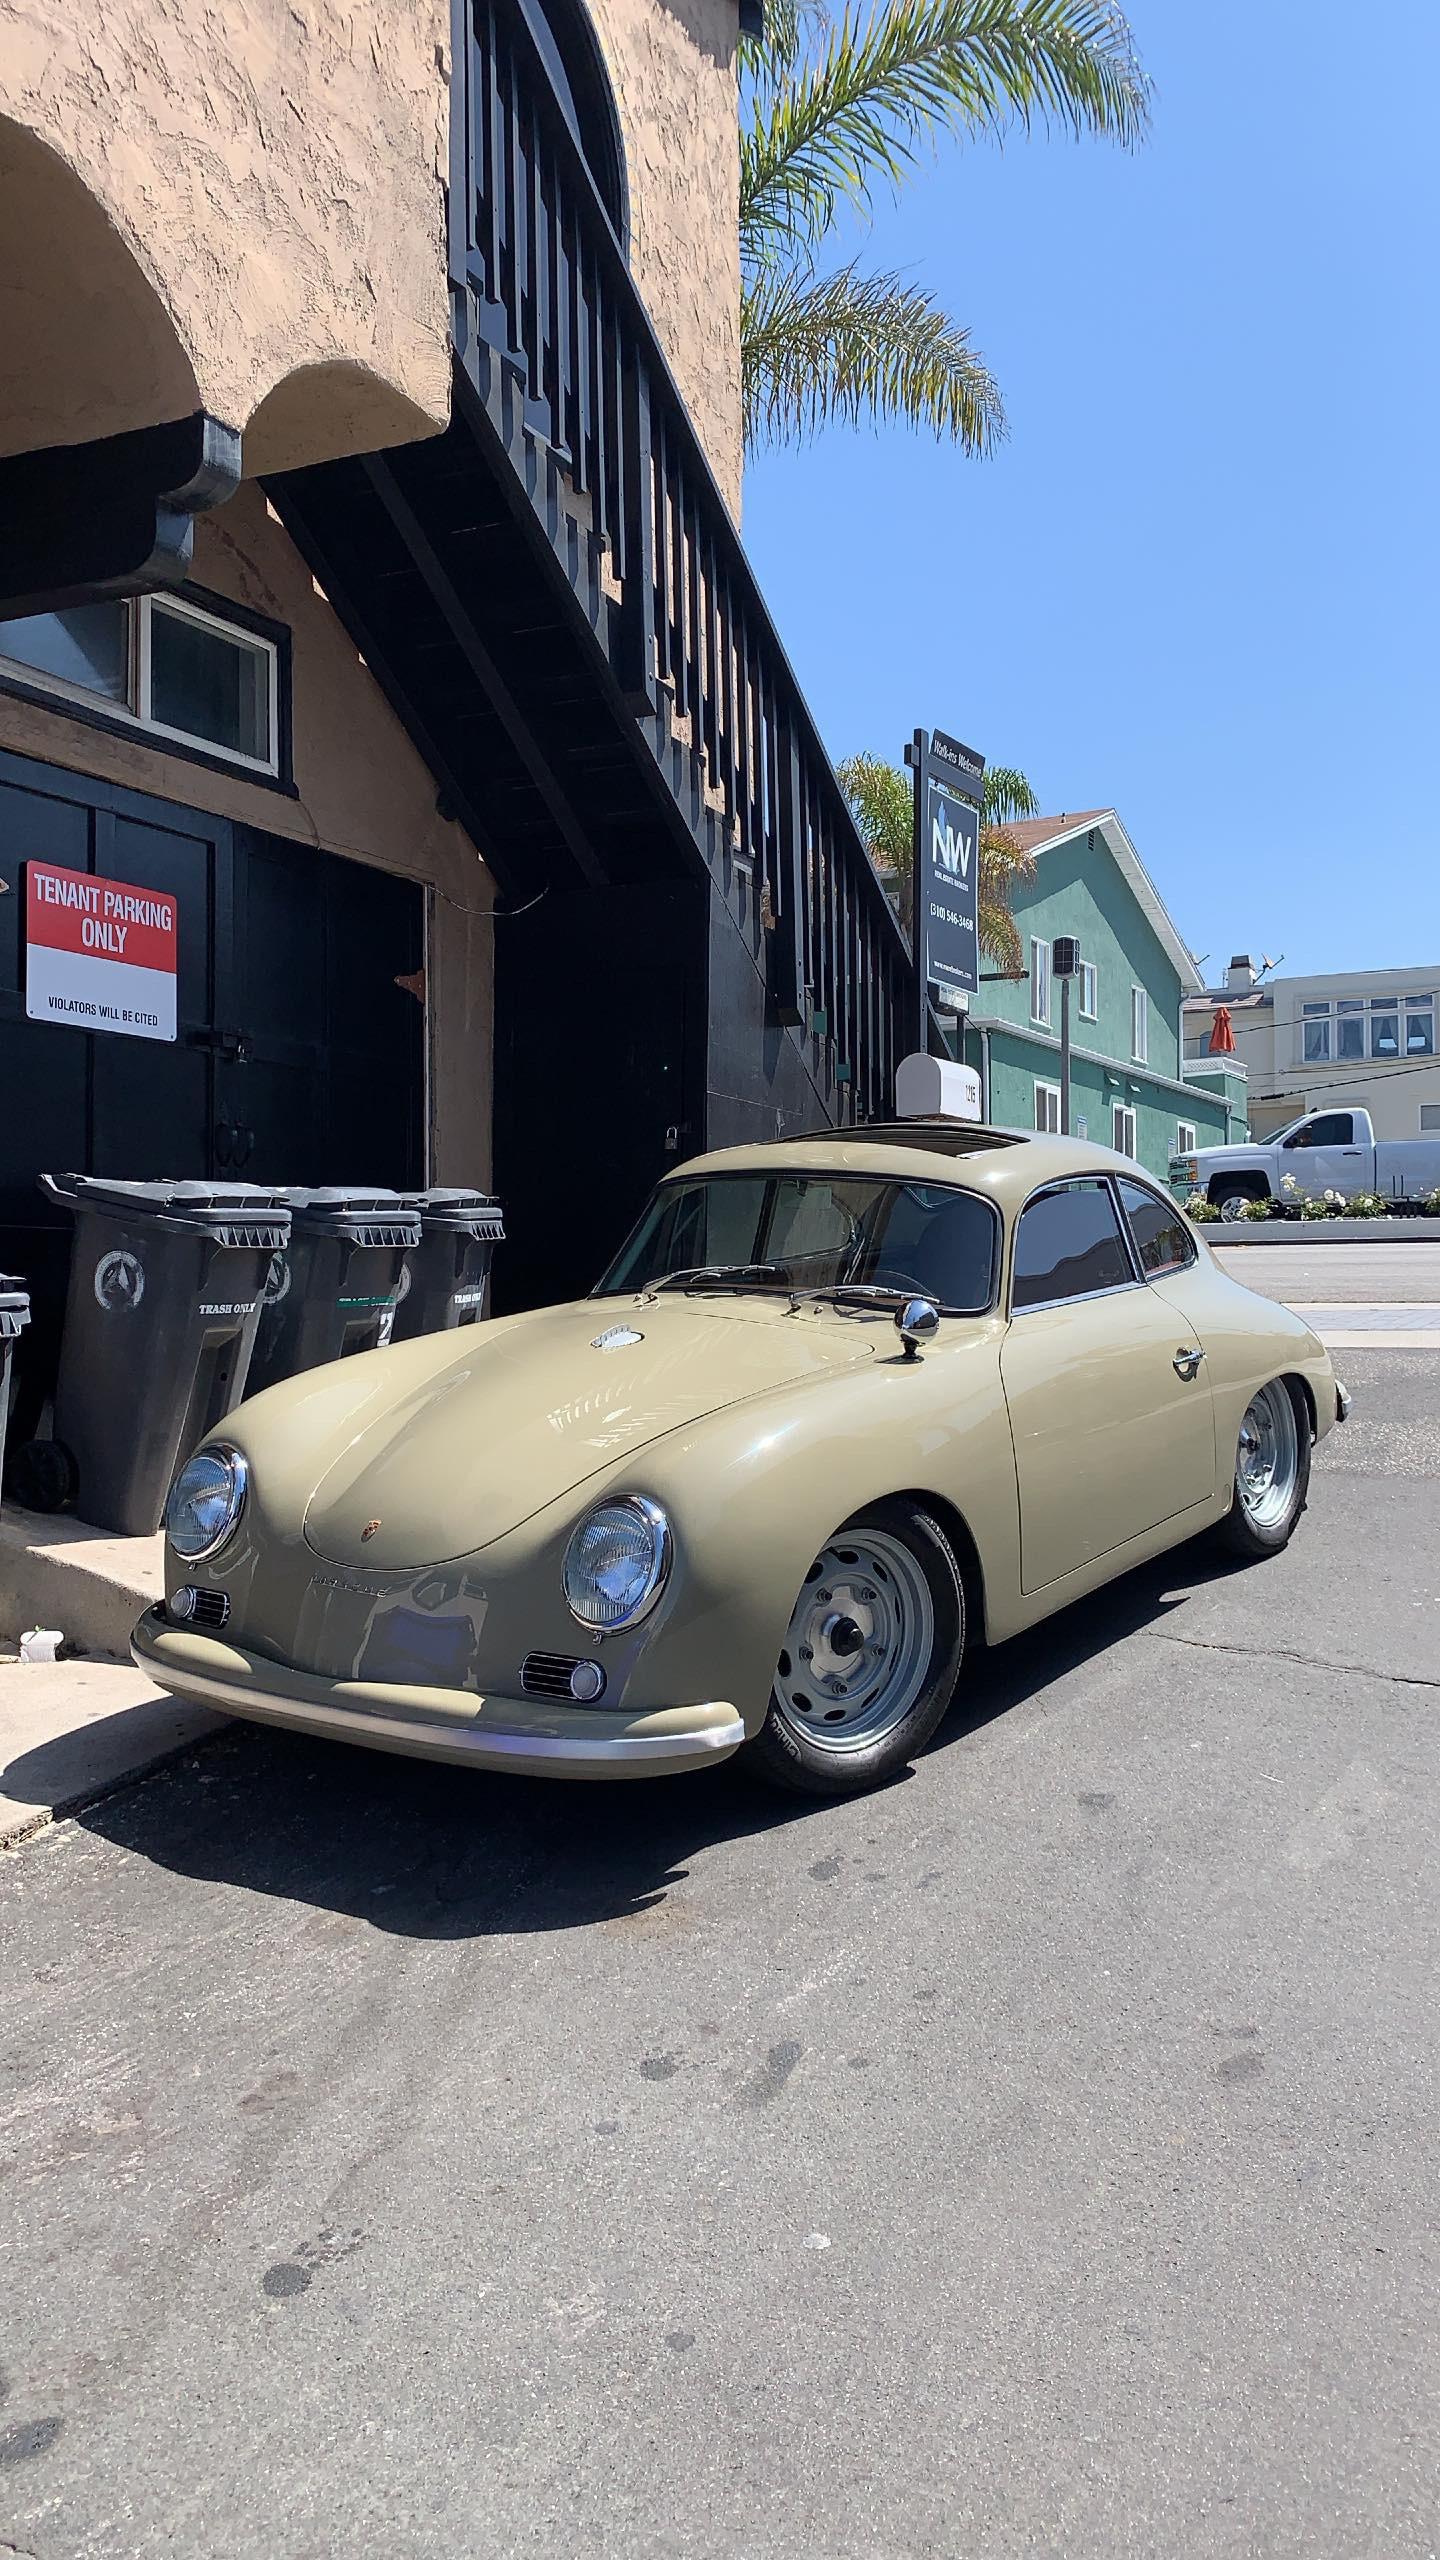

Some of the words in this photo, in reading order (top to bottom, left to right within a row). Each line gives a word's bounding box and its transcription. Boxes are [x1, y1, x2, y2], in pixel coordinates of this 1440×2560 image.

[934, 740, 957, 764] Walk-ins
[958, 753, 982, 778] Welcome
[34, 873, 100, 914] TENANT
[104, 890, 172, 932] PARKING
[930, 902, 946, 921] (310)
[81, 917, 128, 954] ONLY
[48, 996, 97, 1016] VIOLATORS
[99, 1005, 120, 1020] WILL
[122, 1010, 133, 1022] BE
[135, 1012, 158, 1026] CITED
[199, 1304, 233, 1315] TRASH
[233, 1302, 256, 1314] ONLY
